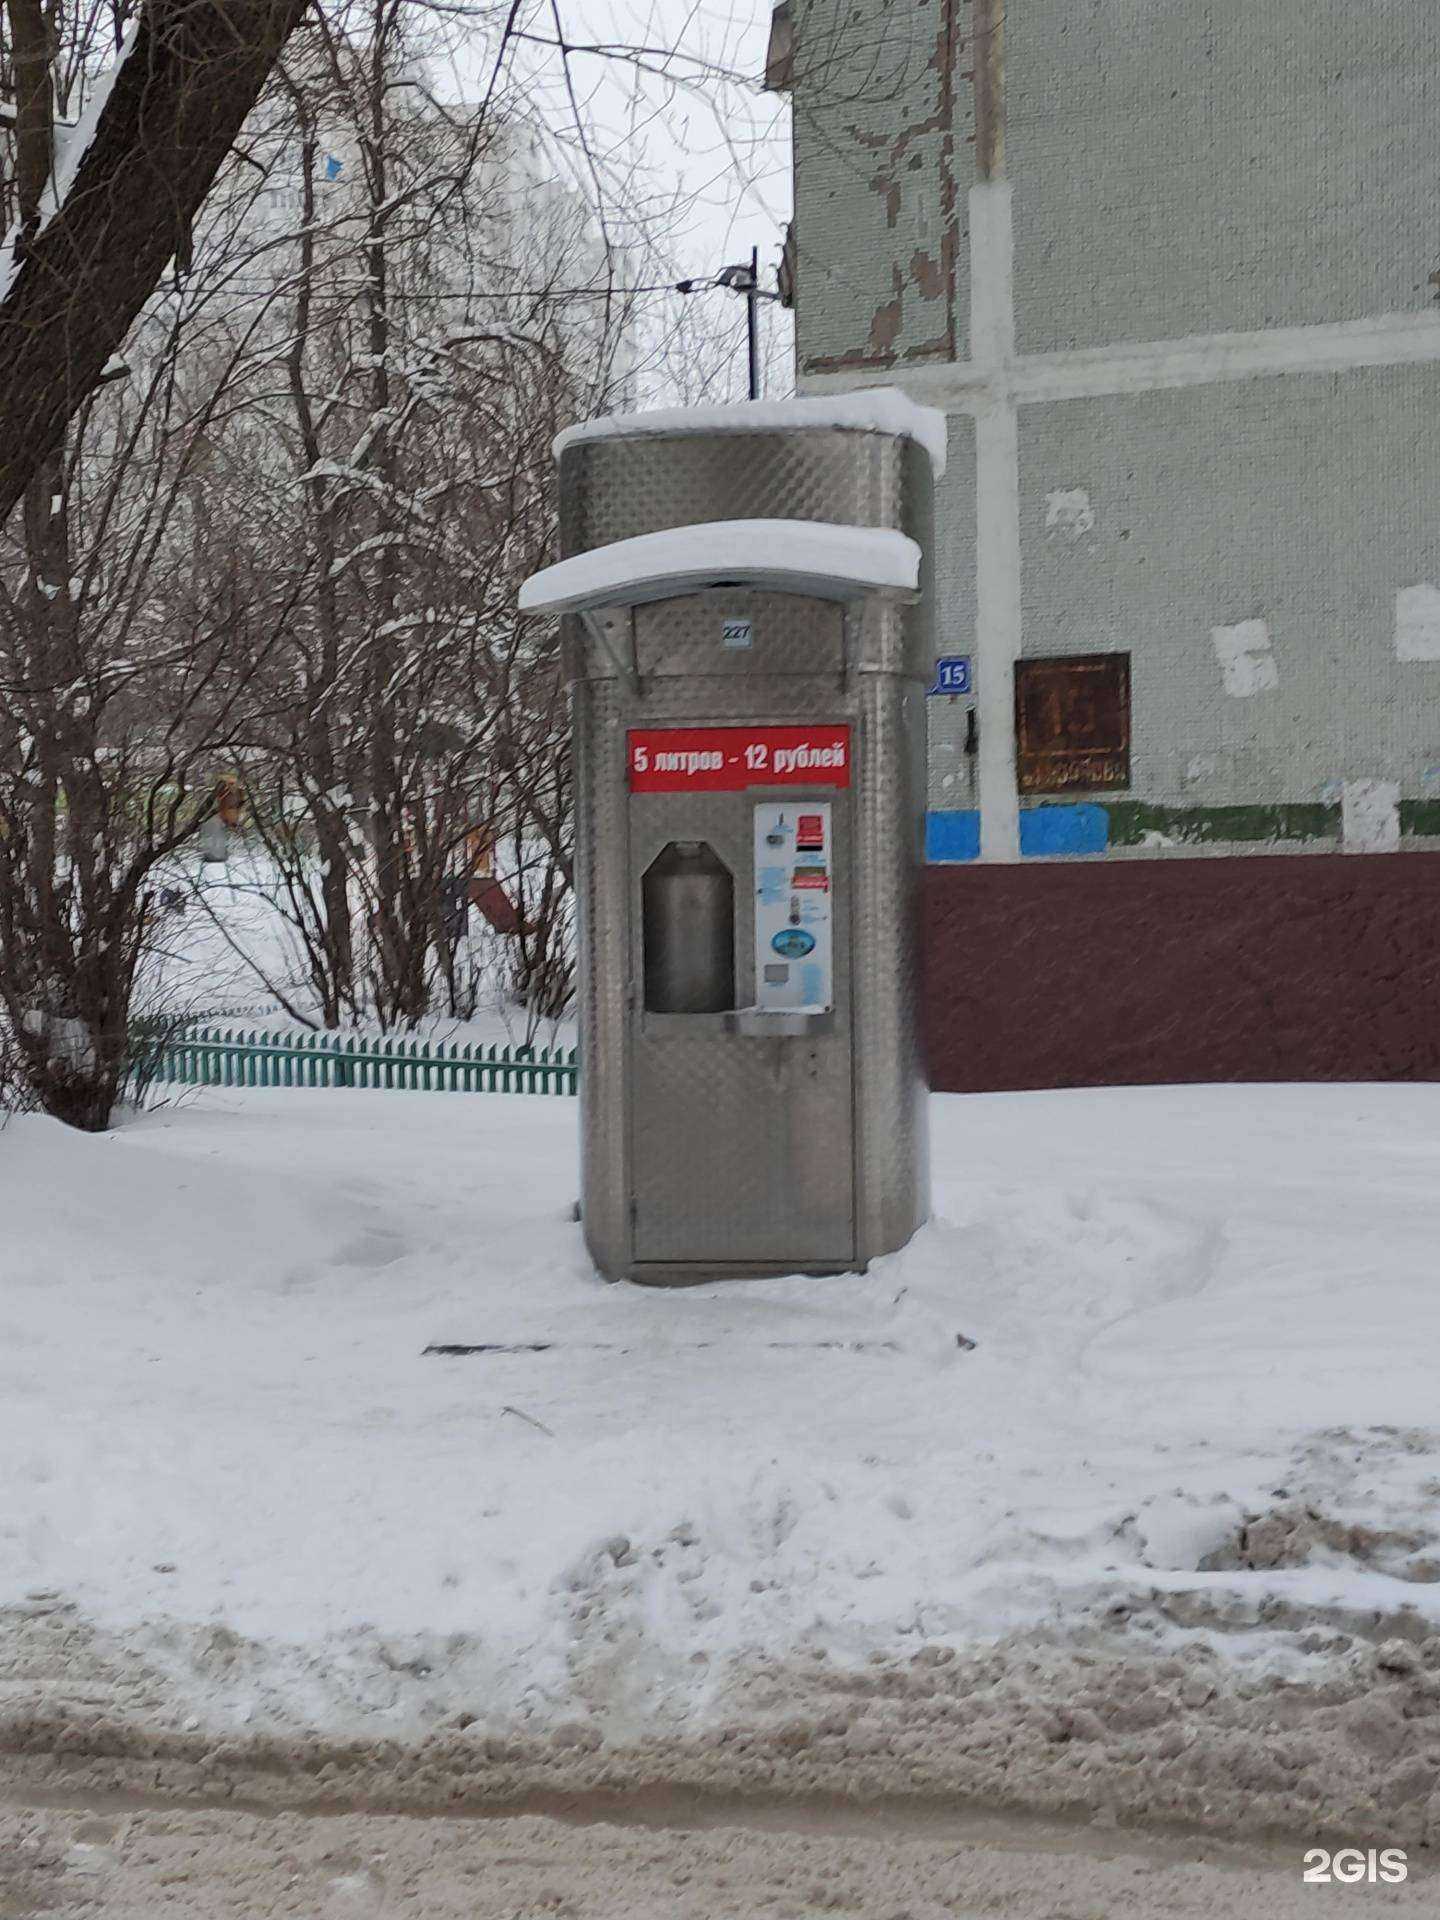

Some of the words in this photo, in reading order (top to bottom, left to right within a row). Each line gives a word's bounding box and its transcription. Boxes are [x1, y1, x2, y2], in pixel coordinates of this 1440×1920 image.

[942, 665, 966, 686] 15
[633, 746, 648, 772] 5
[653, 751, 723, 775] литров
[745, 744, 769, 770] 12
[773, 742, 845, 774] рублей
